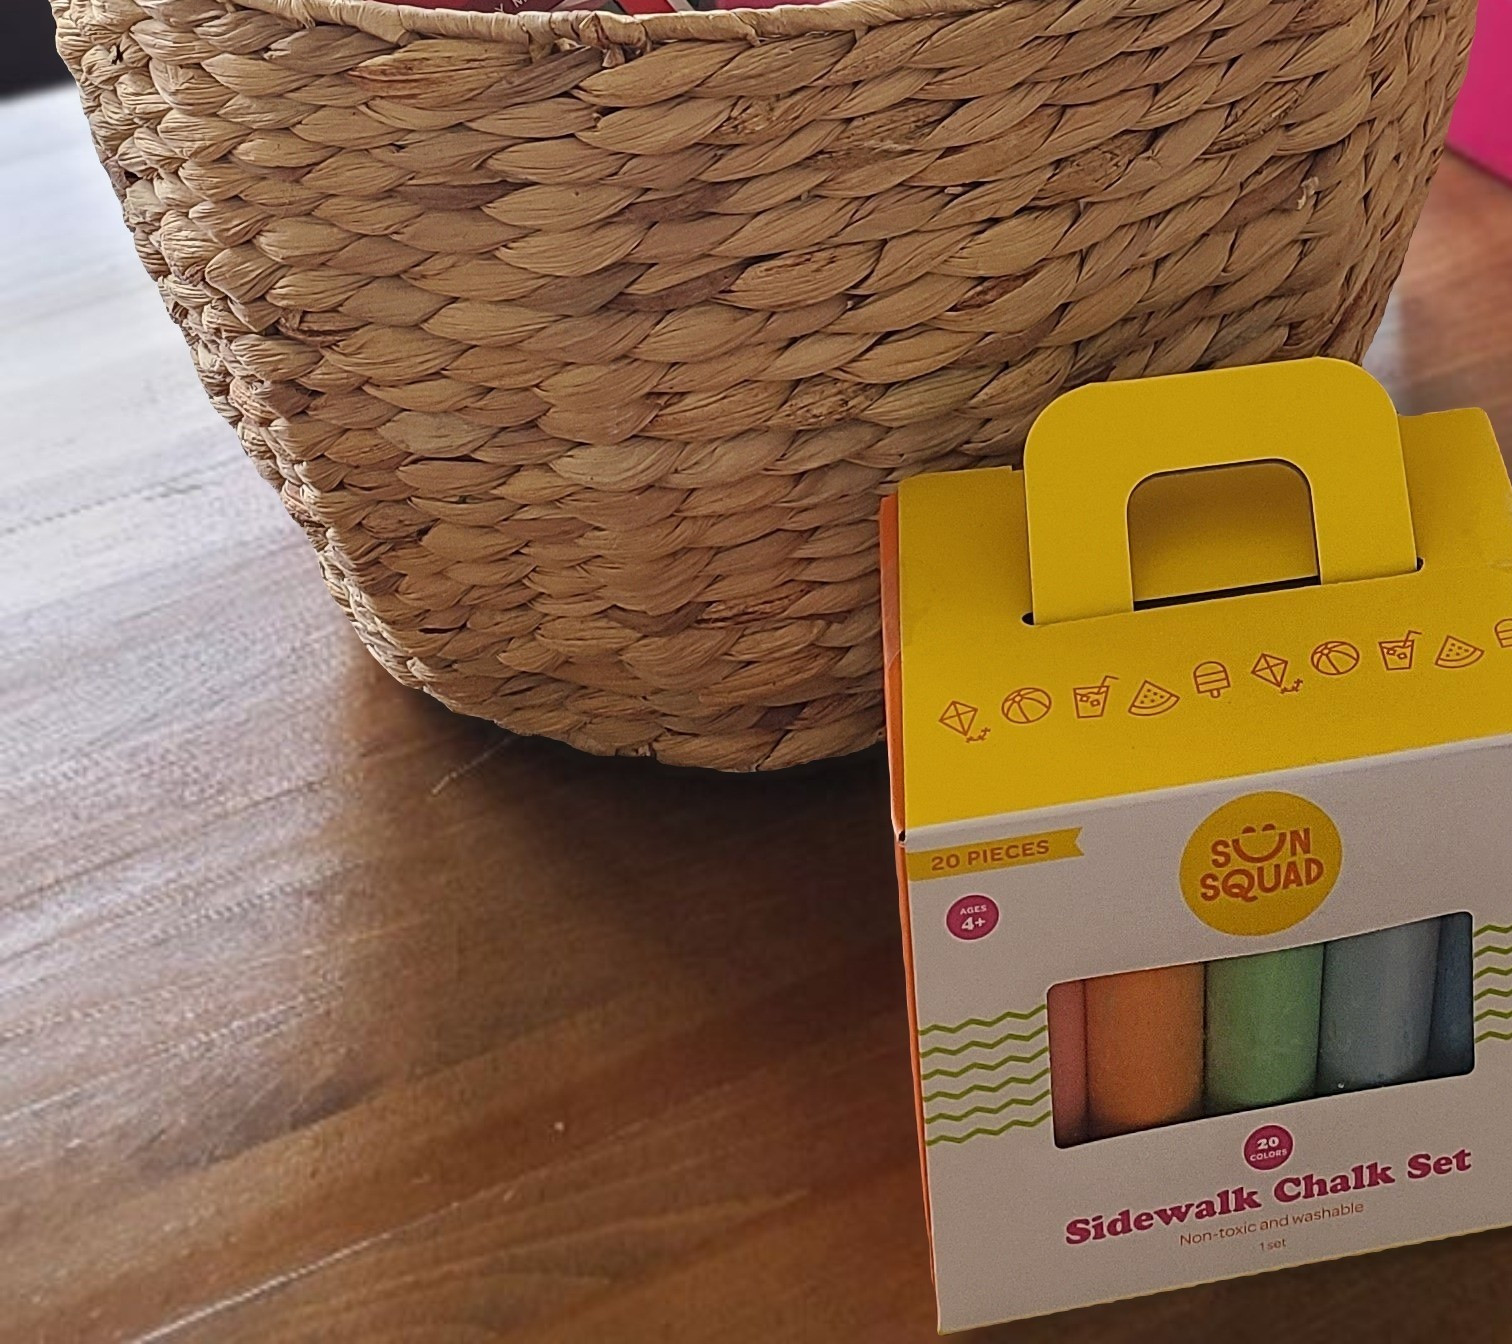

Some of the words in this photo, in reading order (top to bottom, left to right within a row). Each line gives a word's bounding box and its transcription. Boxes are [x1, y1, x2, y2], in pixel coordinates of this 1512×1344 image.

[930, 854, 960, 872] 20
[967, 840, 1050, 867] PIECES
[1211, 824, 1312, 869] SUN
[1200, 857, 1325, 902] SQUAD
[959, 904, 988, 916] AGES
[961, 916, 987, 931] 4+
[1257, 1136, 1280, 1150] 20
[1249, 1149, 1289, 1162] COLORS
[1065, 1186, 1262, 1246] Sidewalk
[1273, 1161, 1396, 1204] Chalk
[1407, 1148, 1472, 1180] Set
[1179, 1222, 1257, 1248] Non-toxic
[1259, 1214, 1290, 1232] and
[1292, 1201, 1365, 1226] washable
[1266, 1238, 1287, 1251] set
